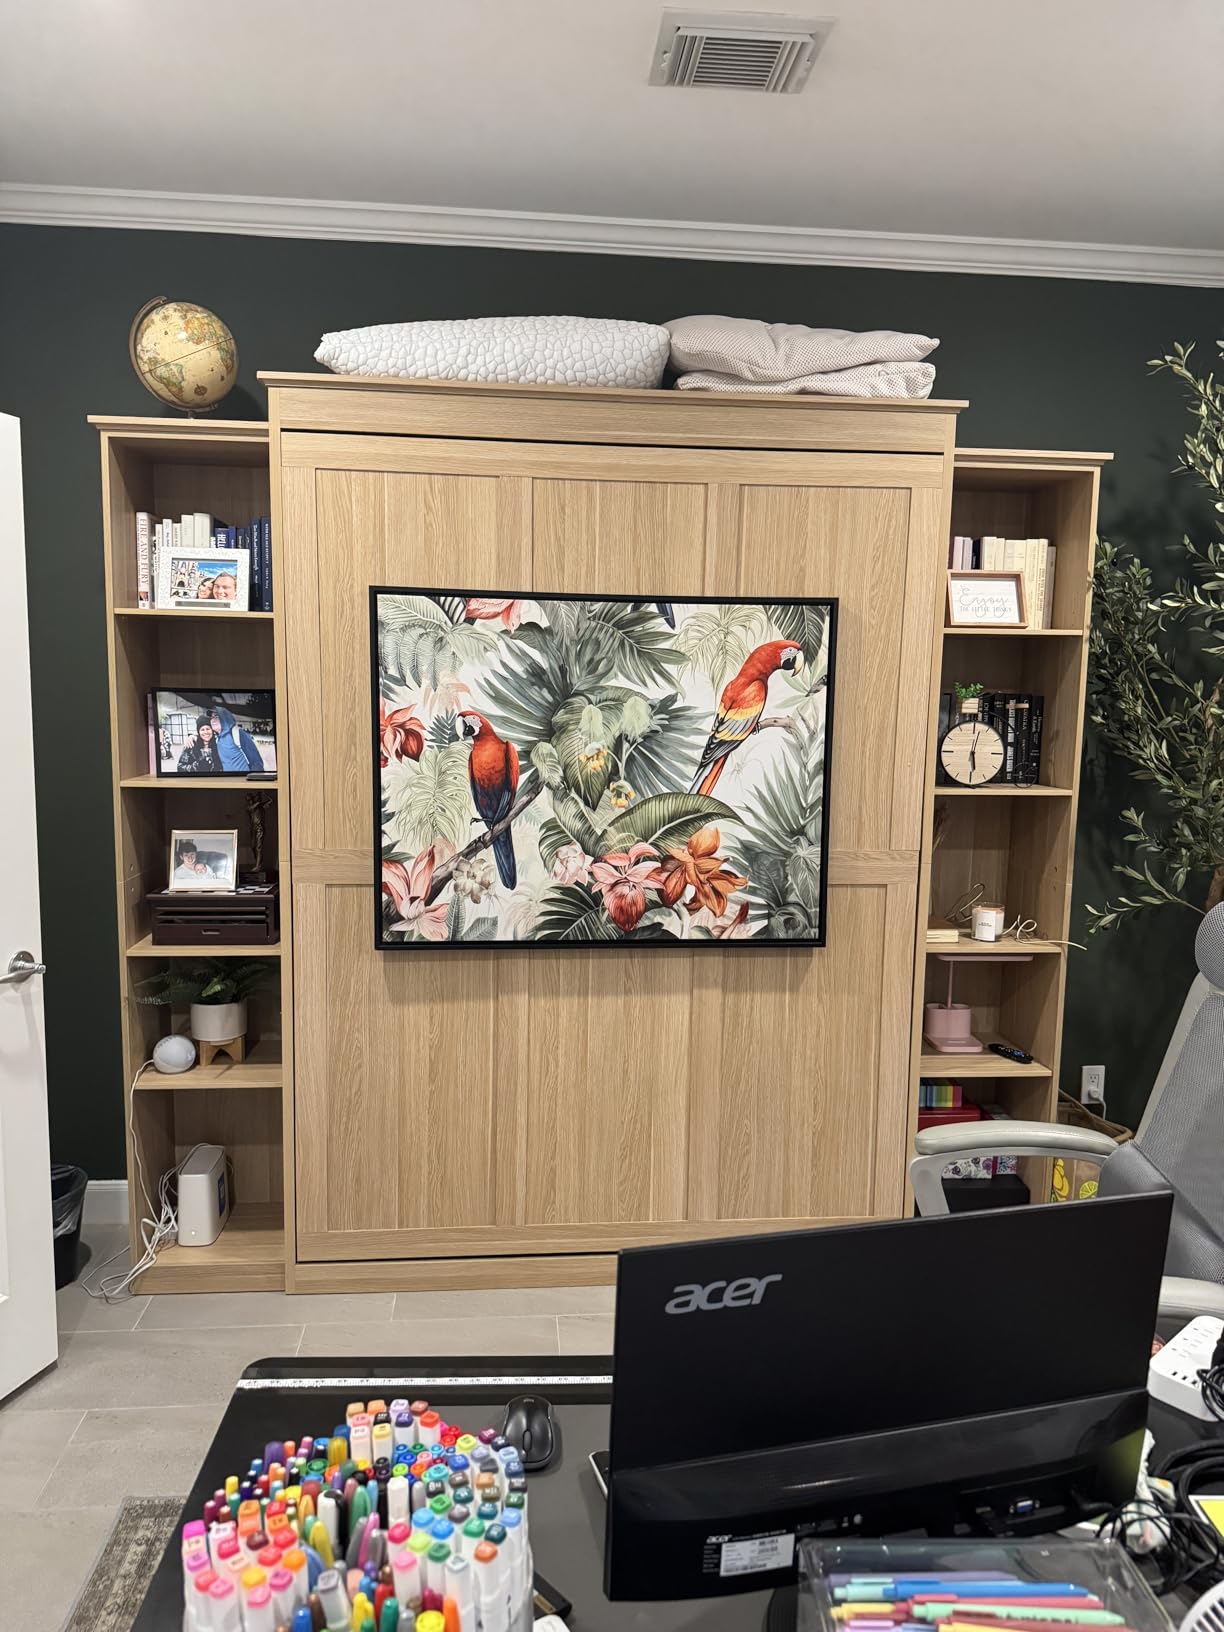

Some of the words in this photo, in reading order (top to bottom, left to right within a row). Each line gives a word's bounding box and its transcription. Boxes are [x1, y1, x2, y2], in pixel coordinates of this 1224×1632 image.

[140, 518, 148, 537] FIRE
[140, 541, 148, 560] AND
[141, 562, 149, 585] FURY
[959, 586, 1009, 618] Enjoy
[665, 1274, 783, 1314] acer
[706, 1534, 734, 1544] acer
